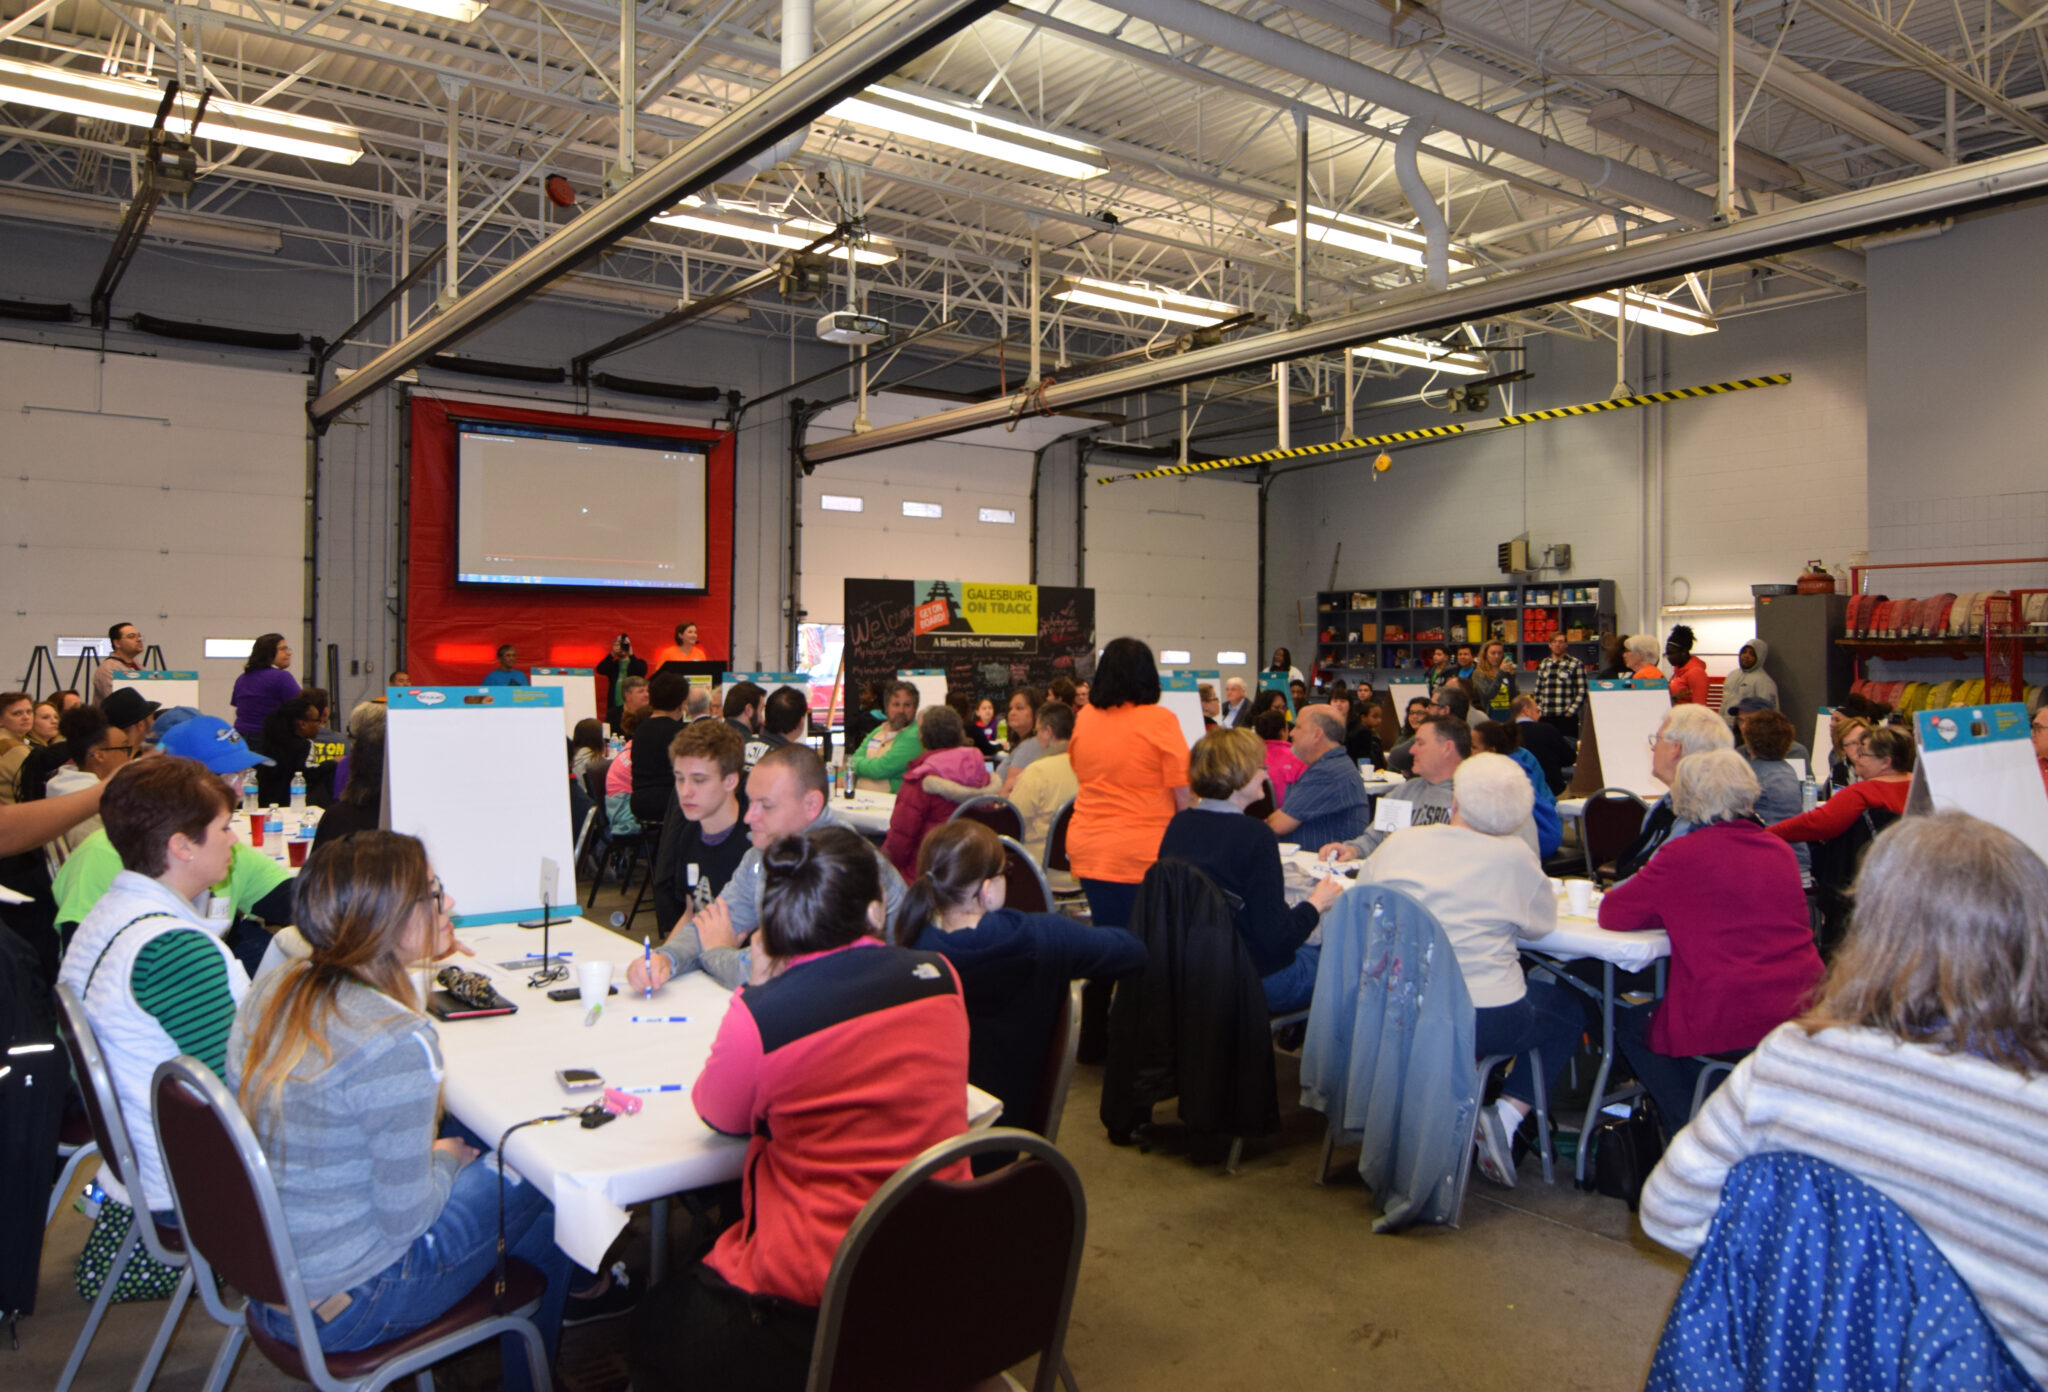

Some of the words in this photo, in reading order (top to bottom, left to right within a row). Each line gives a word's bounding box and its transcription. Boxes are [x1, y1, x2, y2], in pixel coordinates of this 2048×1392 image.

[967, 588, 1032, 601] GALESBURG
[919, 606, 932, 619] GET
[932, 603, 943, 615] ON
[967, 602, 987, 613] ON
[991, 603, 1032, 615] TRACK
[920, 612, 946, 629] BOARD!
[933, 638, 940, 648] A
[940, 637, 960, 648] Heart
[984, 638, 1025, 650] Community
